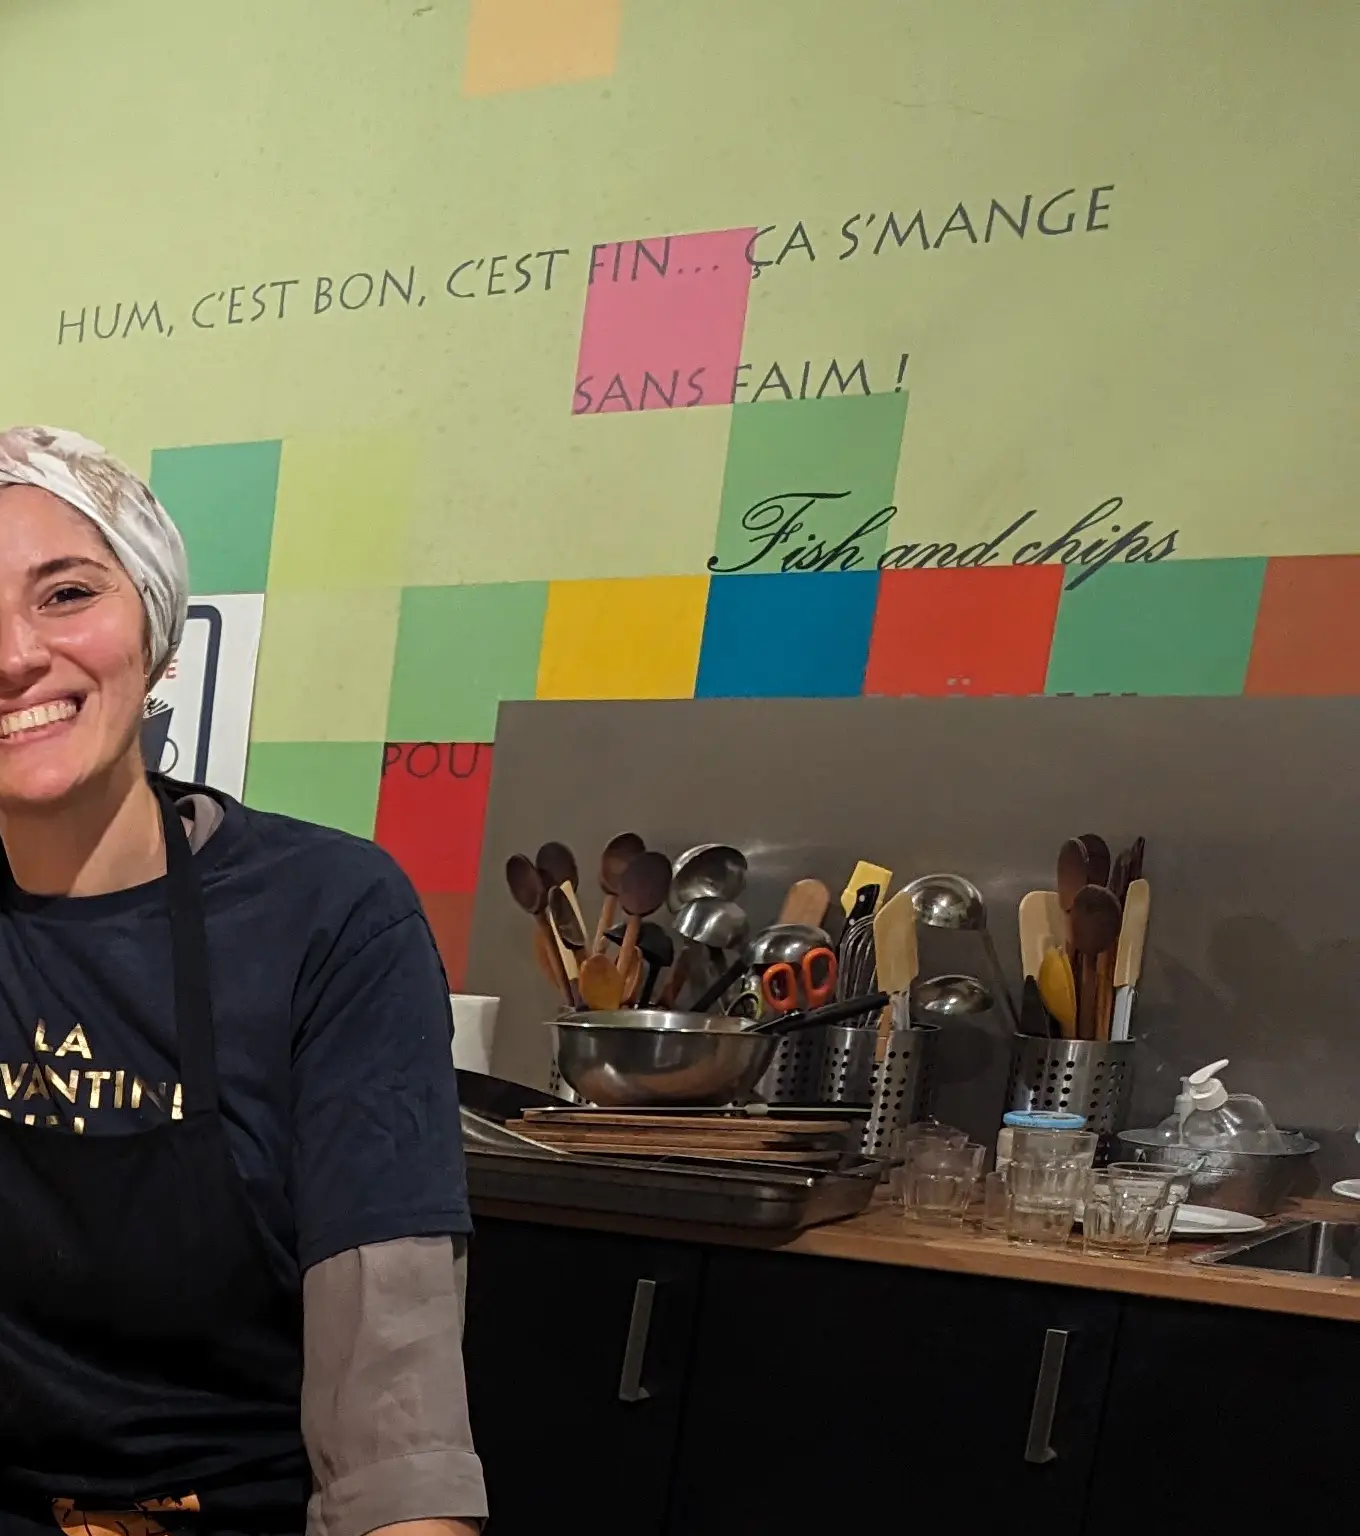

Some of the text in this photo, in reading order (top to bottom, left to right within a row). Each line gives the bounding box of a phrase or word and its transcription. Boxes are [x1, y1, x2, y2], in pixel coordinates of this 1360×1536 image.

[58, 185, 1115, 345] HUM, C'EST BON, C'EST FIN... ÇA S'MANGE
[572, 367, 706, 415] SANS
[730, 358, 873, 404] FAIM
[707, 491, 1180, 591] Fish and chips
[380, 741, 494, 778] POU
[34, 1017, 92, 1060] LA
